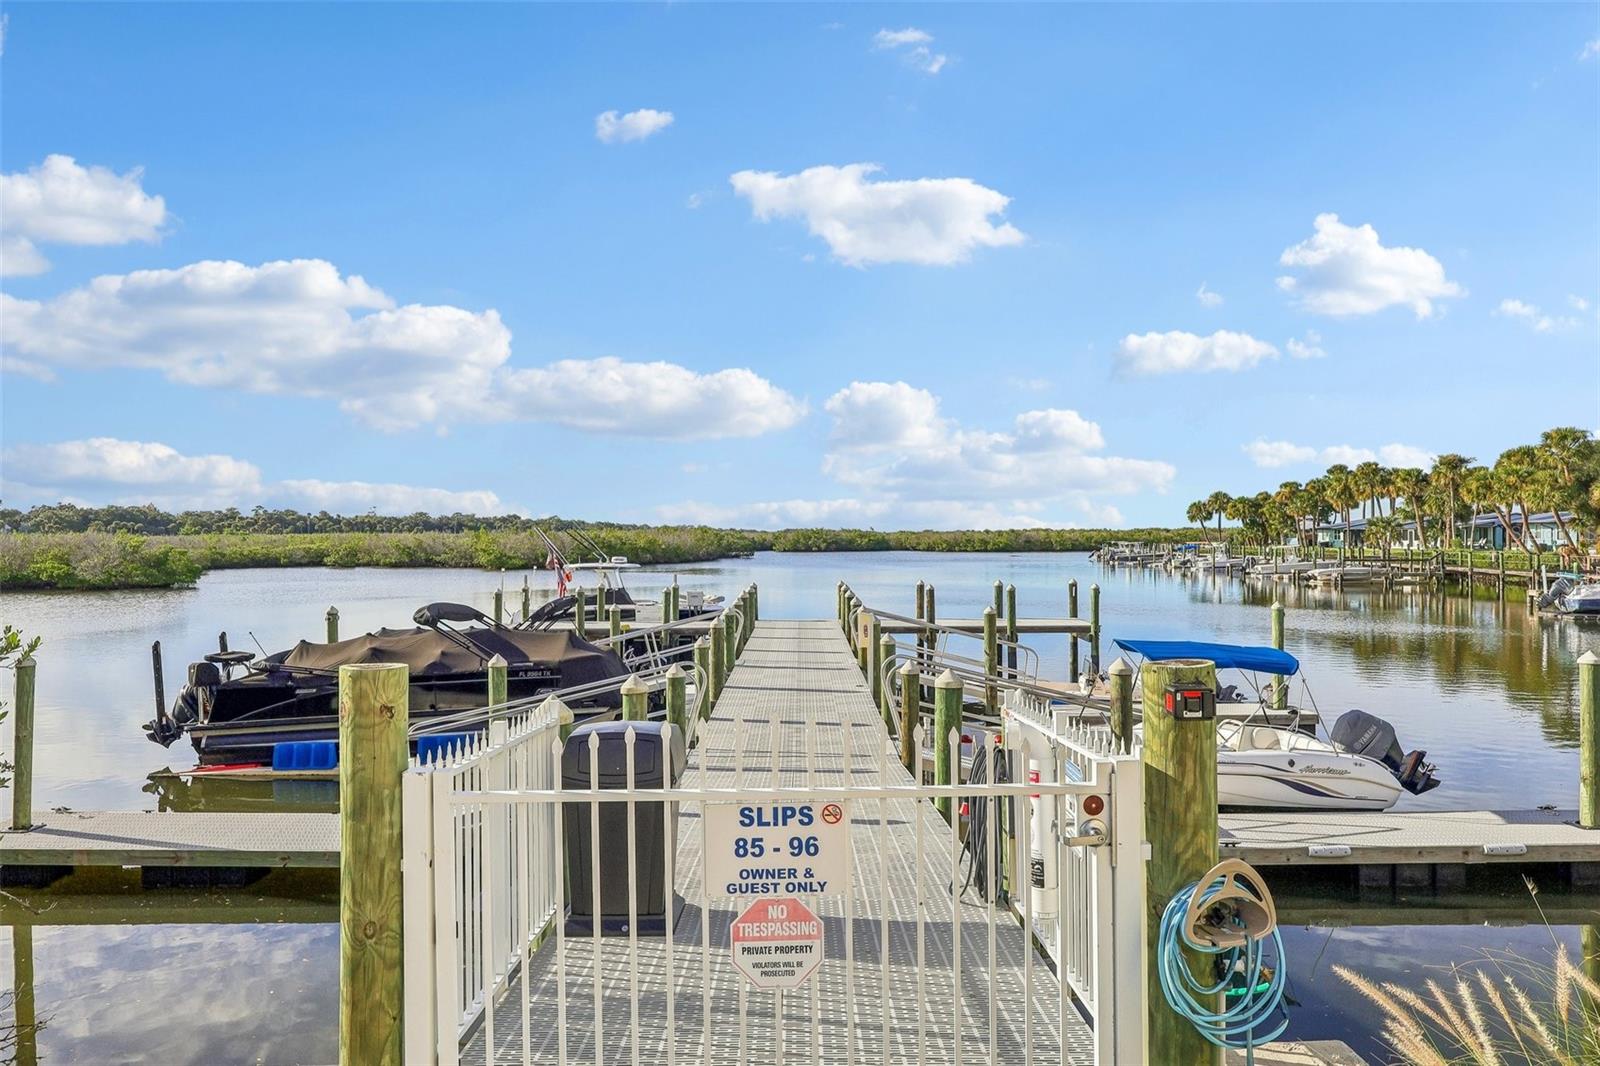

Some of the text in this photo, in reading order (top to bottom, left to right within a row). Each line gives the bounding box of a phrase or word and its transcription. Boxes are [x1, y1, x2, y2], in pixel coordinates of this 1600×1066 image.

[739, 806, 814, 827] SLIPS
[734, 837, 764, 858] 85
[788, 836, 820, 856] 96
[739, 868, 814, 880] OWNER &
[726, 881, 828, 894] GUEST ONLY
[768, 904, 787, 919] NO
[738, 922, 818, 937] TRESPASSING
[742, 944, 814, 956] PRIVATE PROPERTY
